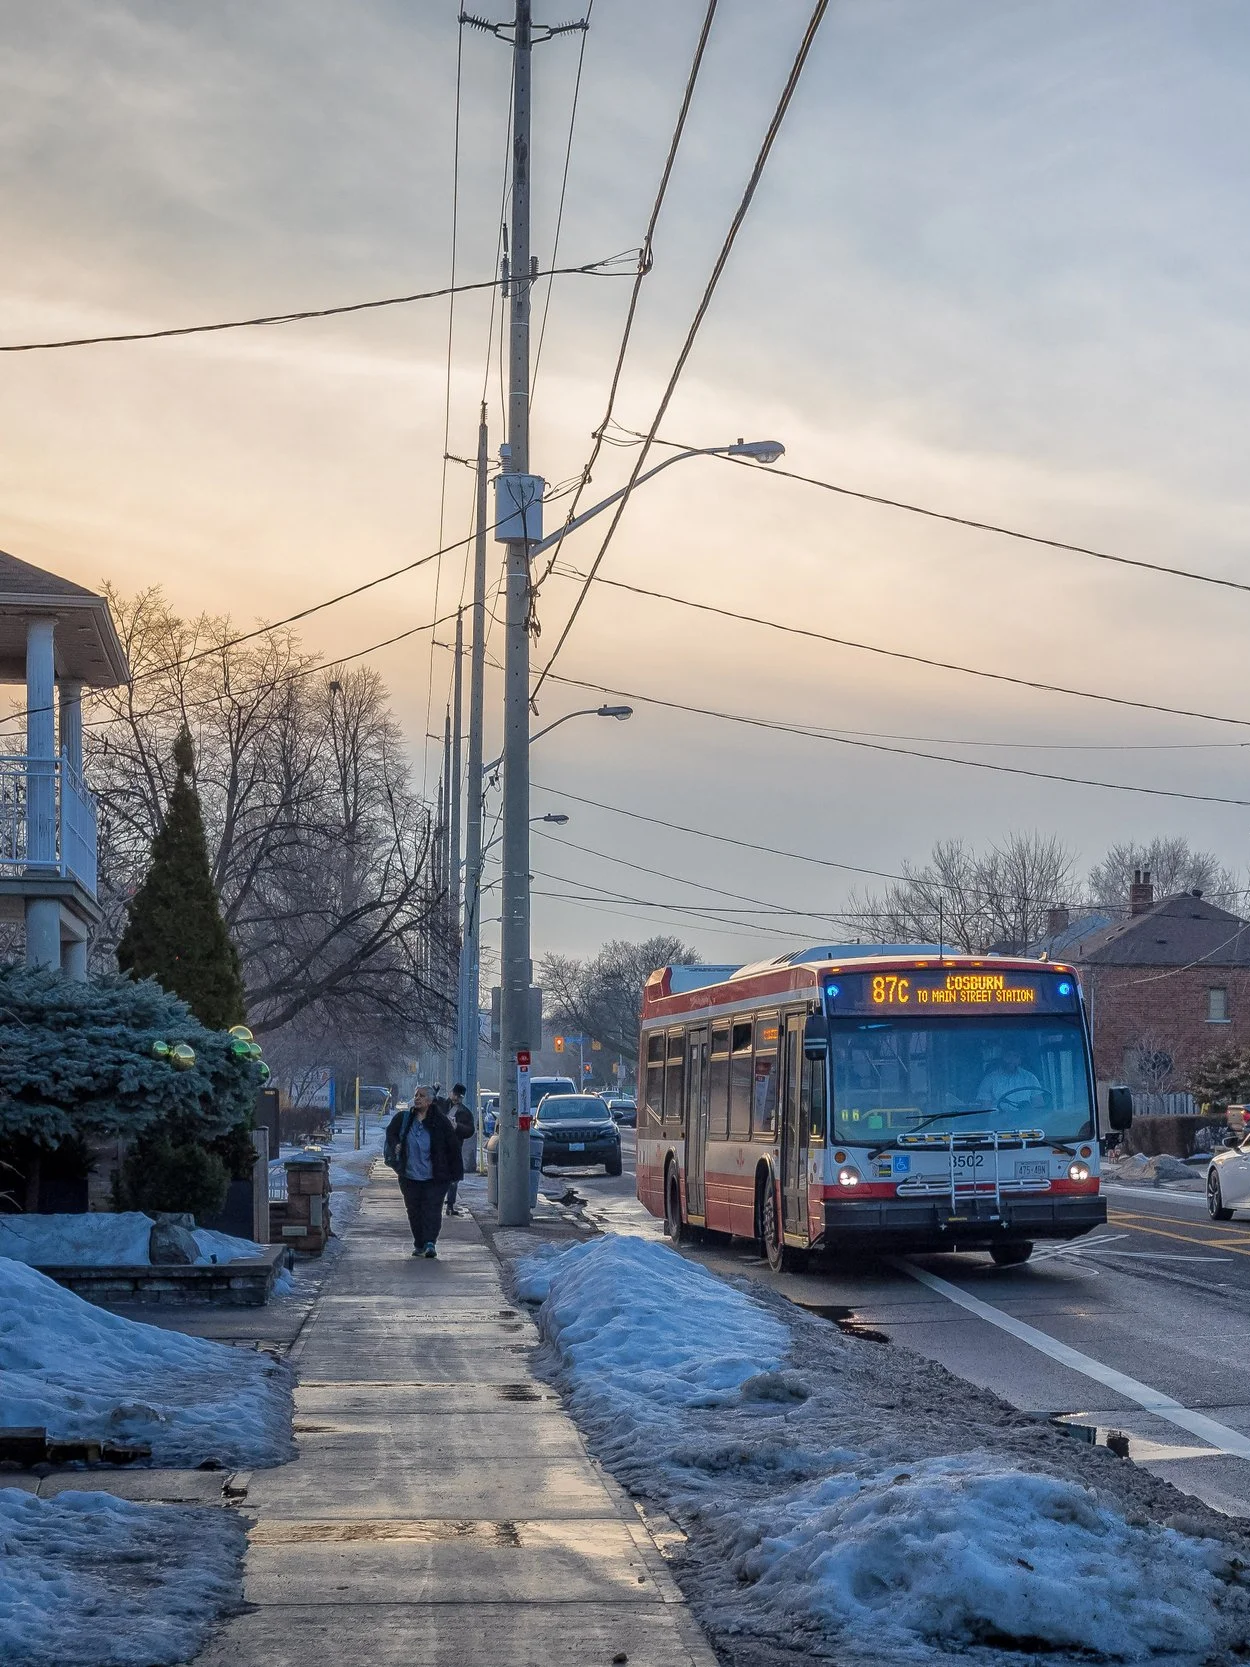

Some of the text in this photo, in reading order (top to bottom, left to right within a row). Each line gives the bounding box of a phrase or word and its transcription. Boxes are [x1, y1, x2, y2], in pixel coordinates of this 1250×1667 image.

[872, 975, 910, 1003] 87C
[946, 975, 1004, 990] COSBURN
[917, 989, 1034, 1003] TO MAIN STREET STATION
